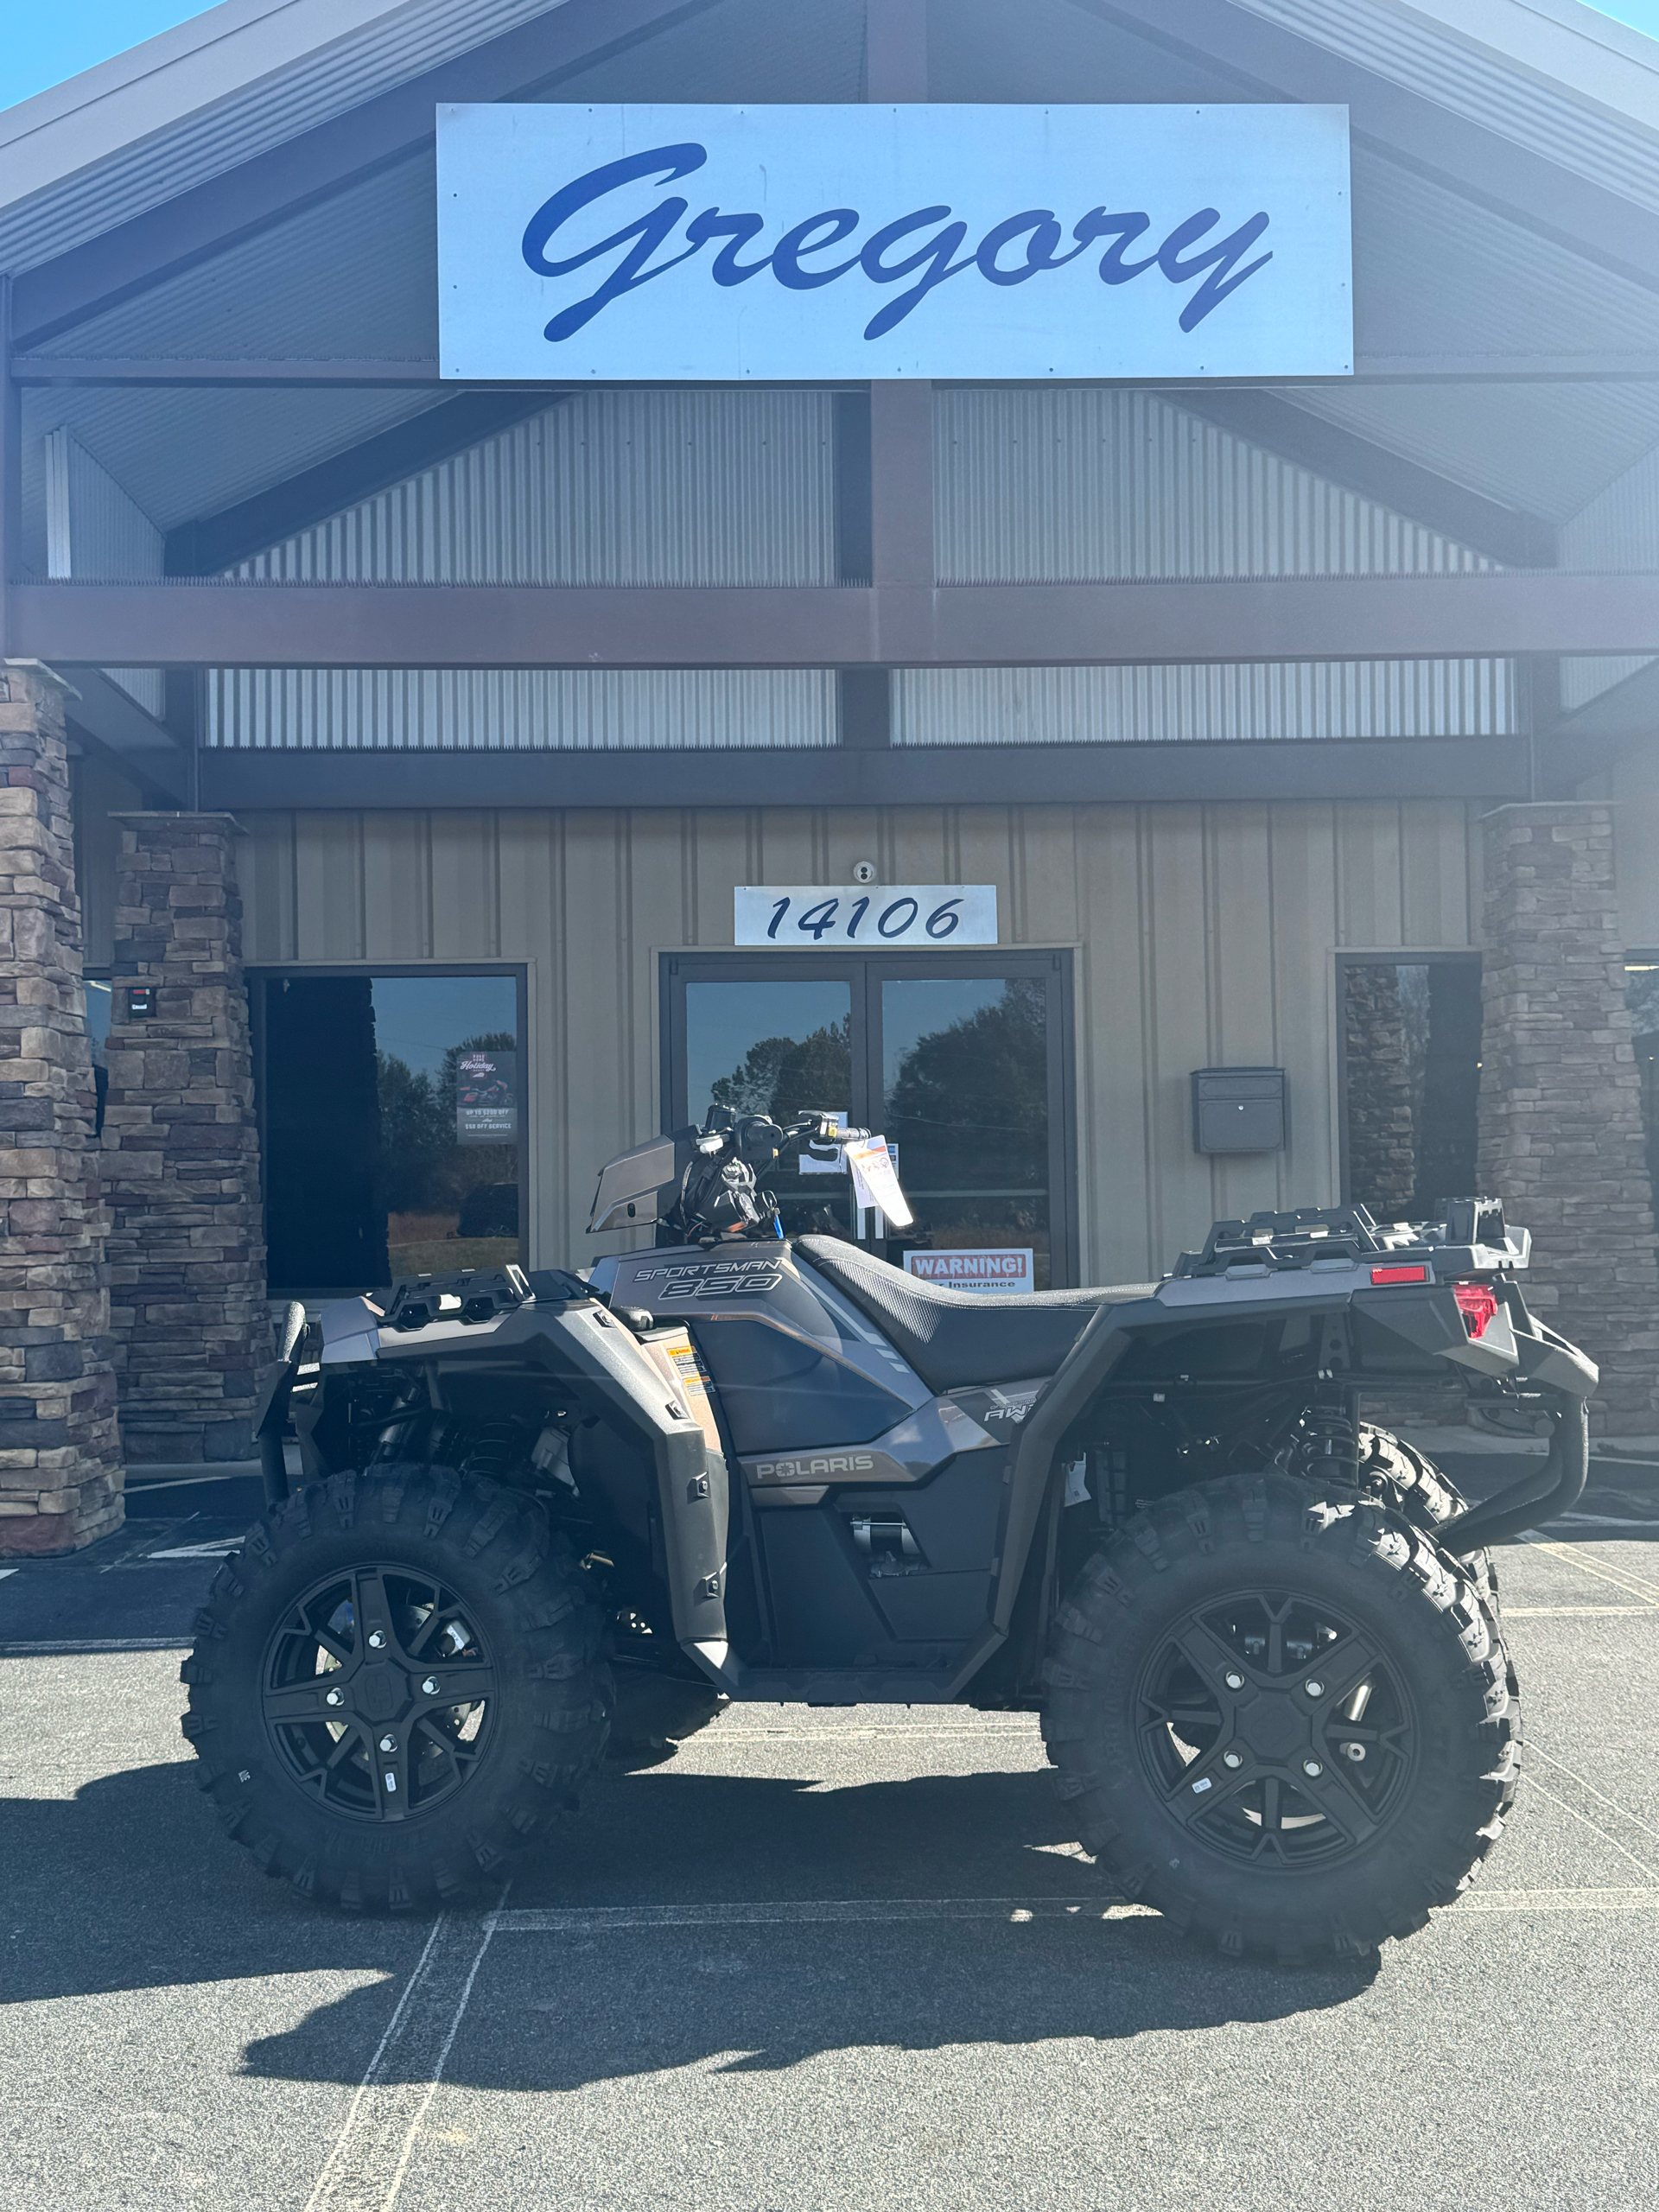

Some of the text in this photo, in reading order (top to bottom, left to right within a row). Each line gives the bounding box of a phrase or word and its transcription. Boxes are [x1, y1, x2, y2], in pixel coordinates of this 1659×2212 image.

[521, 142, 1274, 342] Gregory
[766, 896, 965, 940] 14106
[460, 1060, 496, 1071] Holiday
[632, 1259, 783, 1283] SPORTSMAN
[915, 1257, 1022, 1275] WARNING!
[658, 1273, 783, 1300] 850
[756, 1455, 874, 1479] POLARIS
